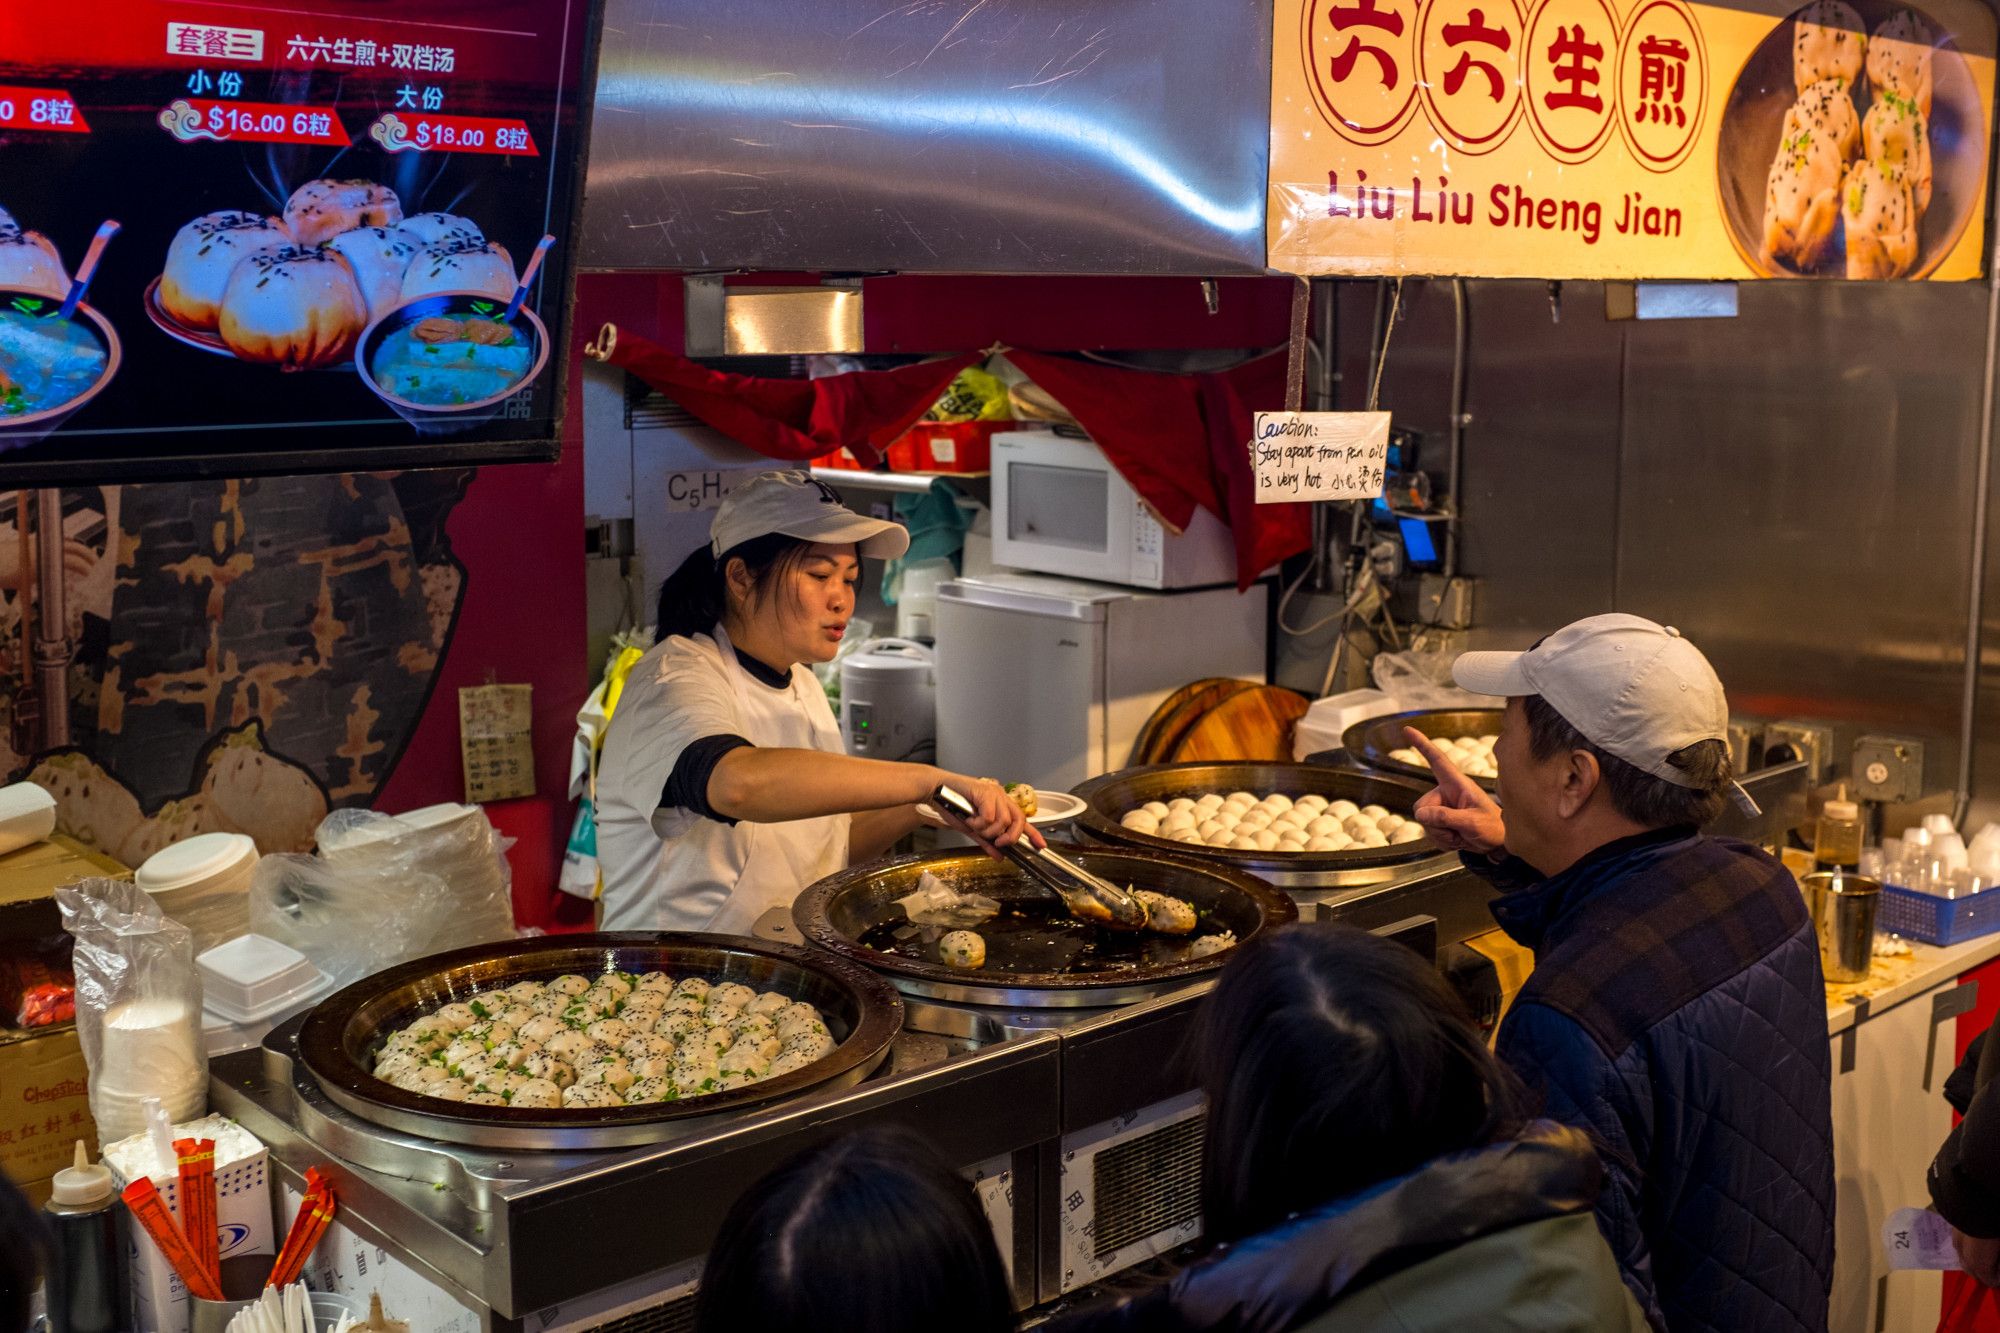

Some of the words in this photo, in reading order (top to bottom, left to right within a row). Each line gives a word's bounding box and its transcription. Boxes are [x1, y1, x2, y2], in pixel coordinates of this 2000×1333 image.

[176, 26, 256, 57] 套餐三
[286, 34, 455, 73] 六六生煎+双档汤
[1328, 0, 1690, 129] 六六生煎
[187, 69, 243, 97] 小份
[395, 84, 444, 110] 大份
[30, 98, 74, 125] 8粒
[208, 105, 285, 134] $16.00
[292, 112, 331, 137] 6粒
[416, 121, 484, 147] $18.00
[495, 128, 528, 150] 8粒
[1328, 169, 1395, 221] Liu
[1412, 175, 1474, 225] Liu
[1488, 183, 1602, 245] Sheng
[1615, 192, 1682, 237] Jian
[1257, 442, 1283, 467] Stay
[1285, 445, 1314, 468] apart
[1317, 445, 1343, 462] from
[1369, 444, 1384, 459] oil
[668, 472, 729, 508] C5H
[1261, 473, 1272, 488] is
[1278, 472, 1299, 493] very
[1304, 466, 1322, 489] hot
[1894, 1230, 1910, 1249] 24
